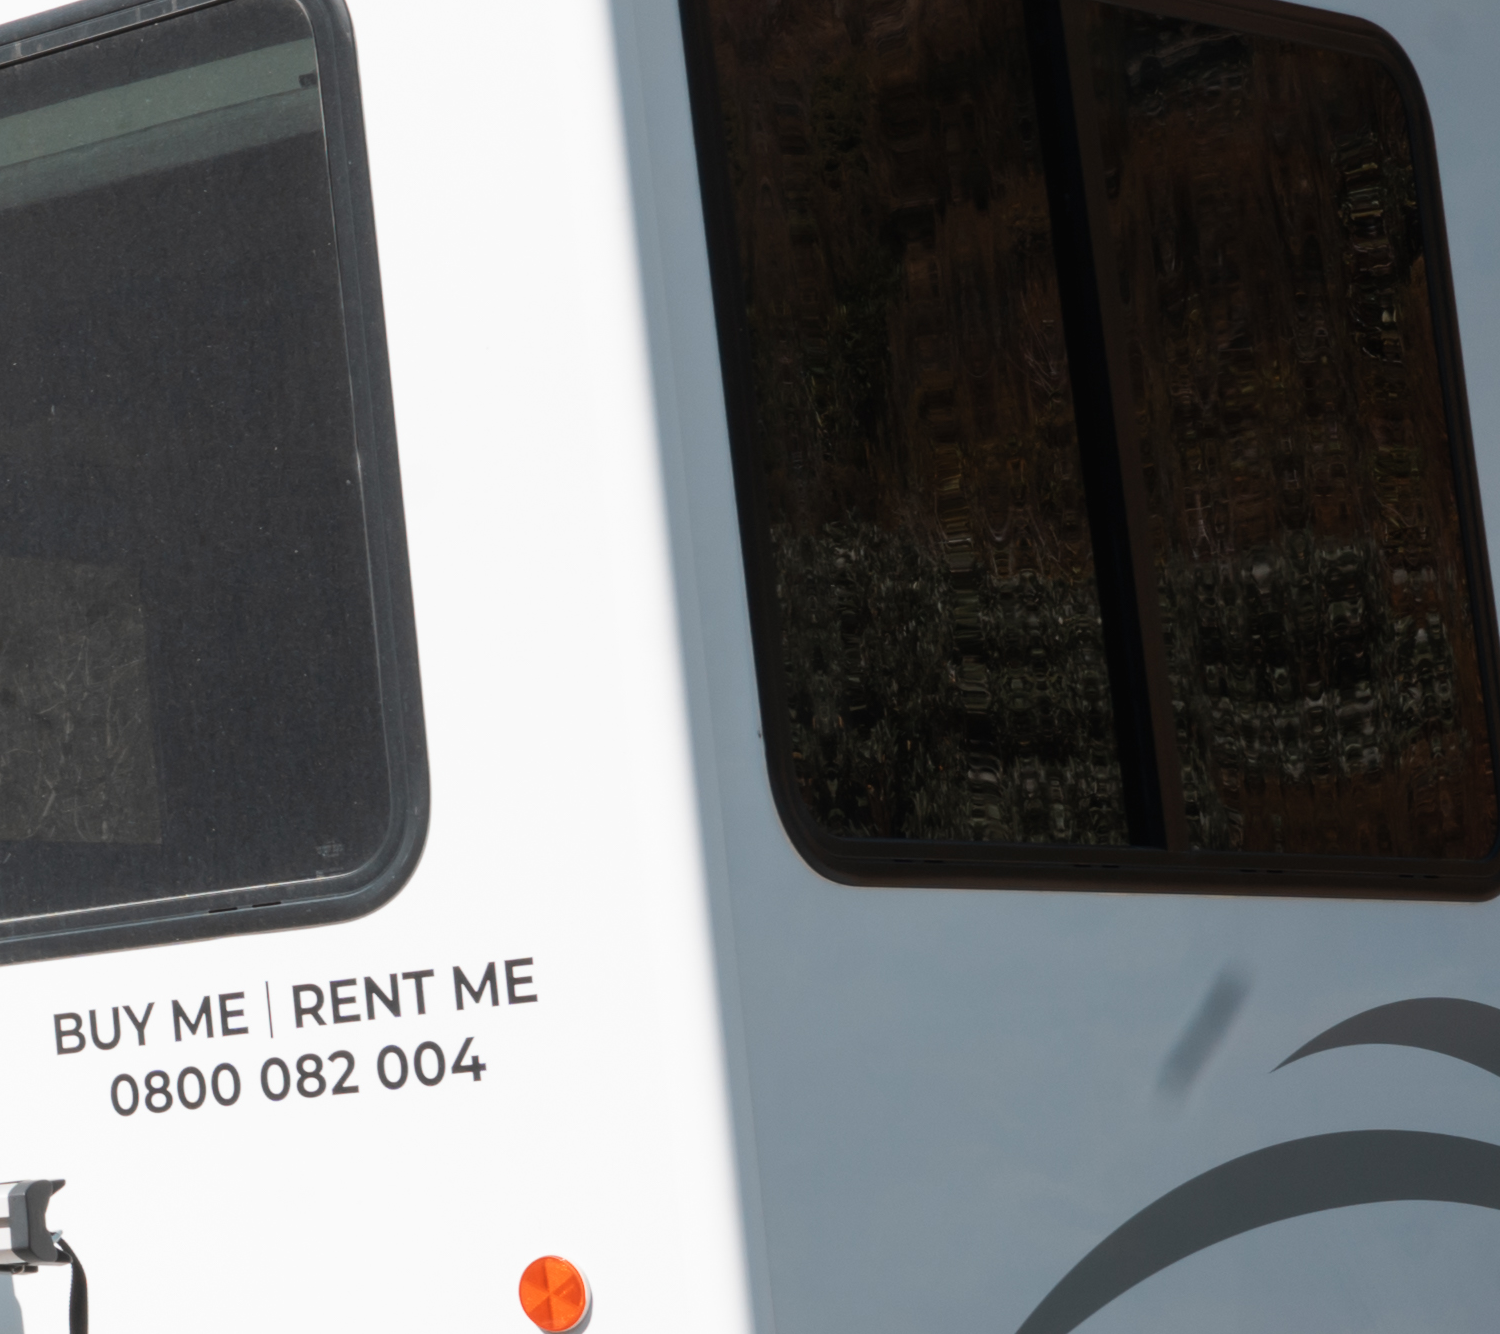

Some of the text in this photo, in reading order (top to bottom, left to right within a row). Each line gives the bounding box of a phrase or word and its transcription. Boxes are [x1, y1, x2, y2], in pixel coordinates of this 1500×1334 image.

[53, 957, 538, 1055] BUY ME RENT ME
[110, 1036, 487, 1117] 0800 082 004
